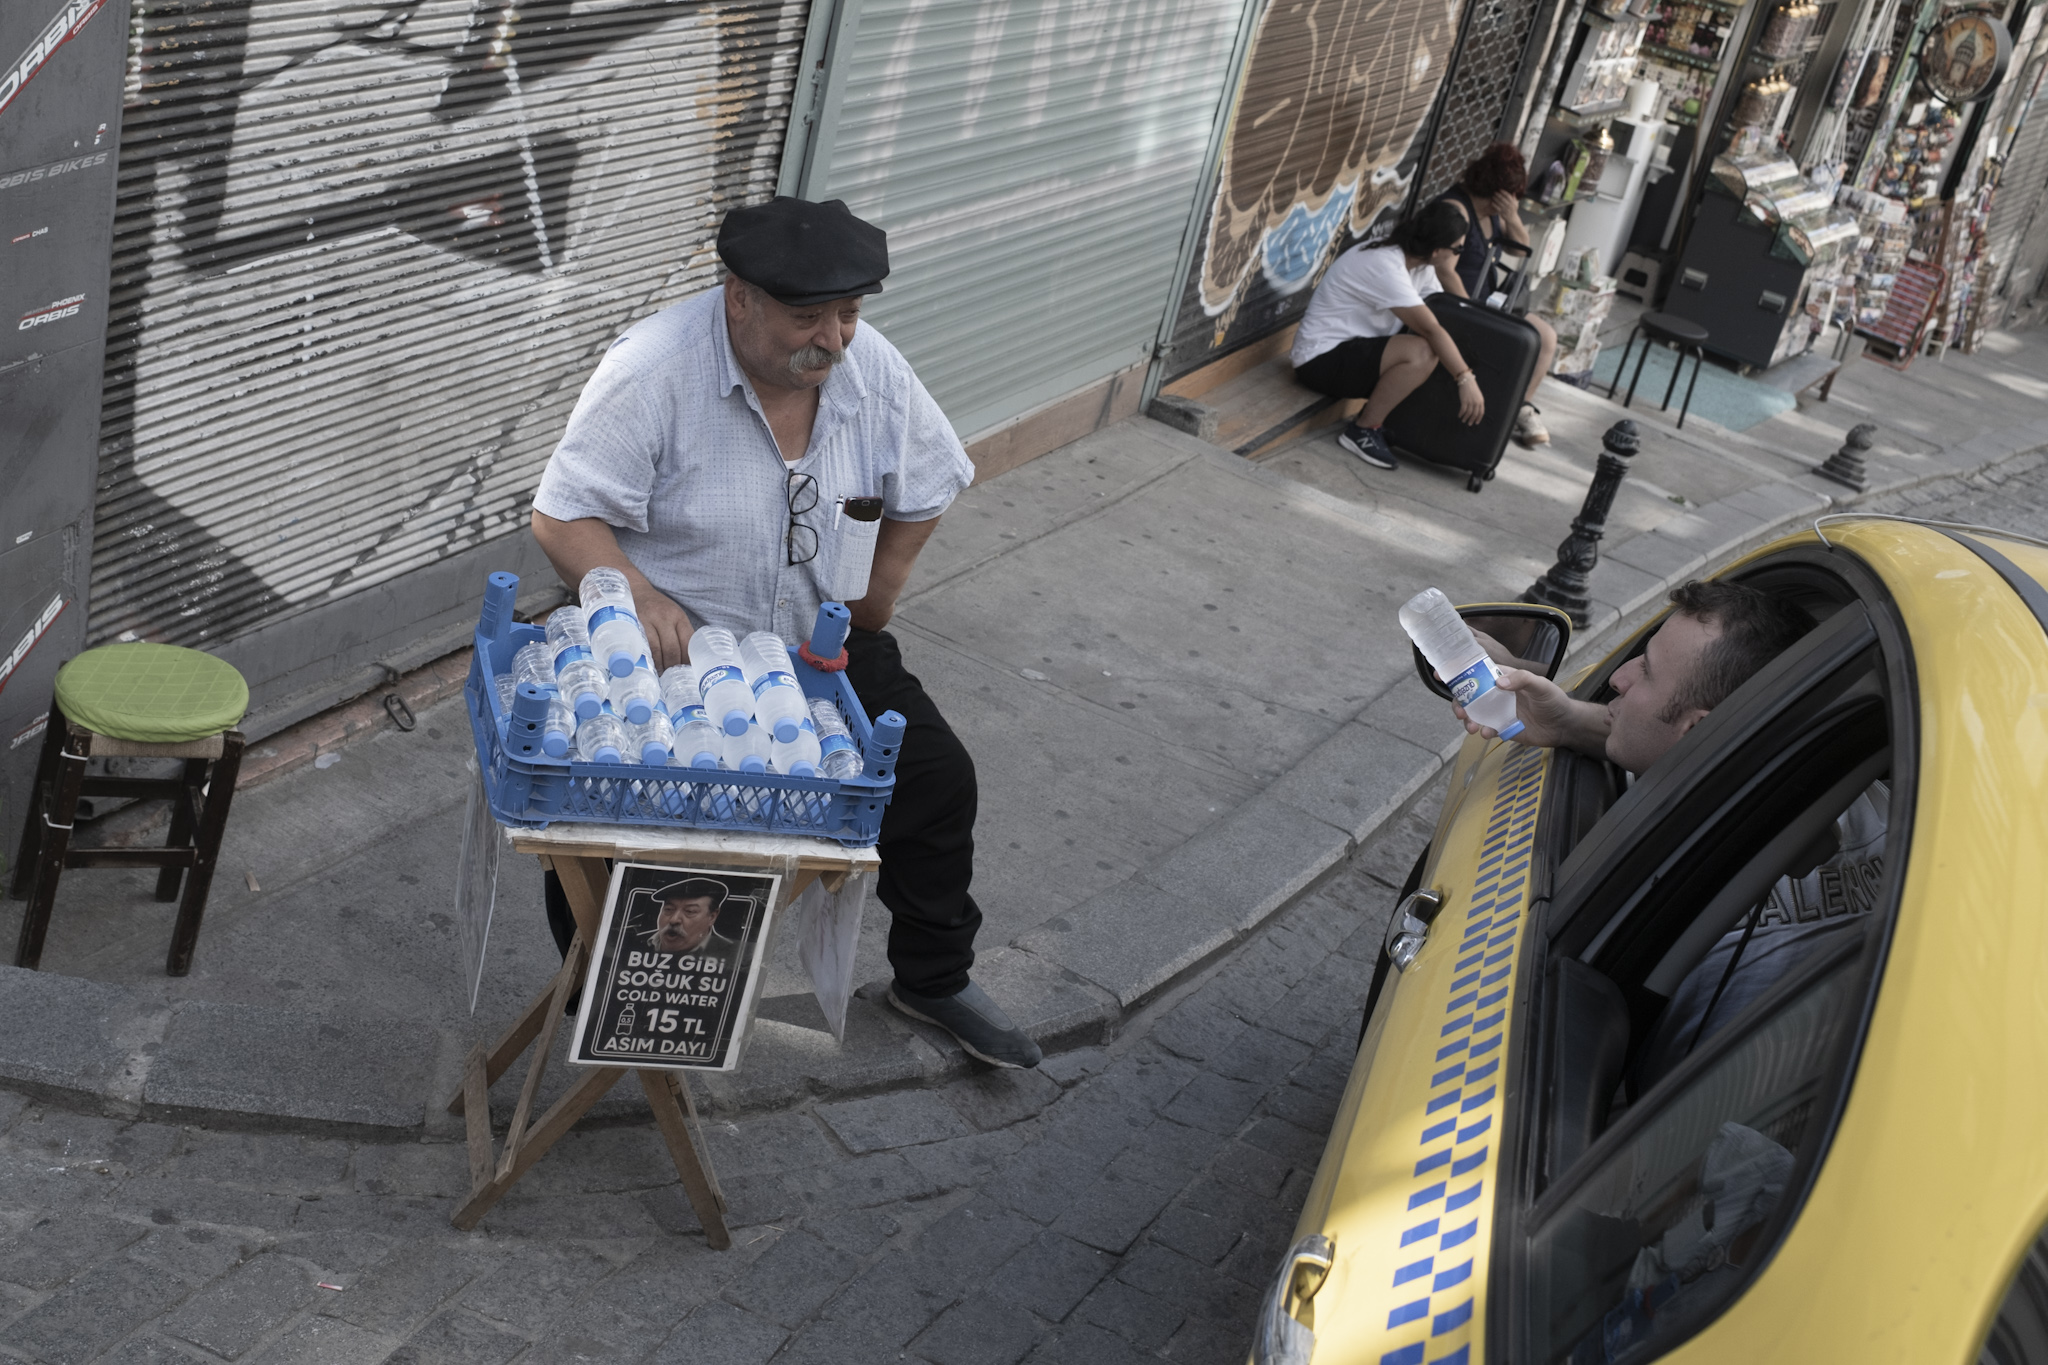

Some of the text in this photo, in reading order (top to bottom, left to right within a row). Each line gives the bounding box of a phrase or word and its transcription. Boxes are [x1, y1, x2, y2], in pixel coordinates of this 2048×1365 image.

[48, 153, 108, 177] BIKES
[52, 293, 86, 308] PHOENIX
[19, 304, 80, 330] ORBIS
[627, 951, 674, 969] BUZ
[618, 969, 727, 993] SOĞUK SU
[616, 989, 719, 1008] COLD WATER
[646, 1008, 706, 1035] 15 TL
[603, 1036, 707, 1056] ASIM DAYI
